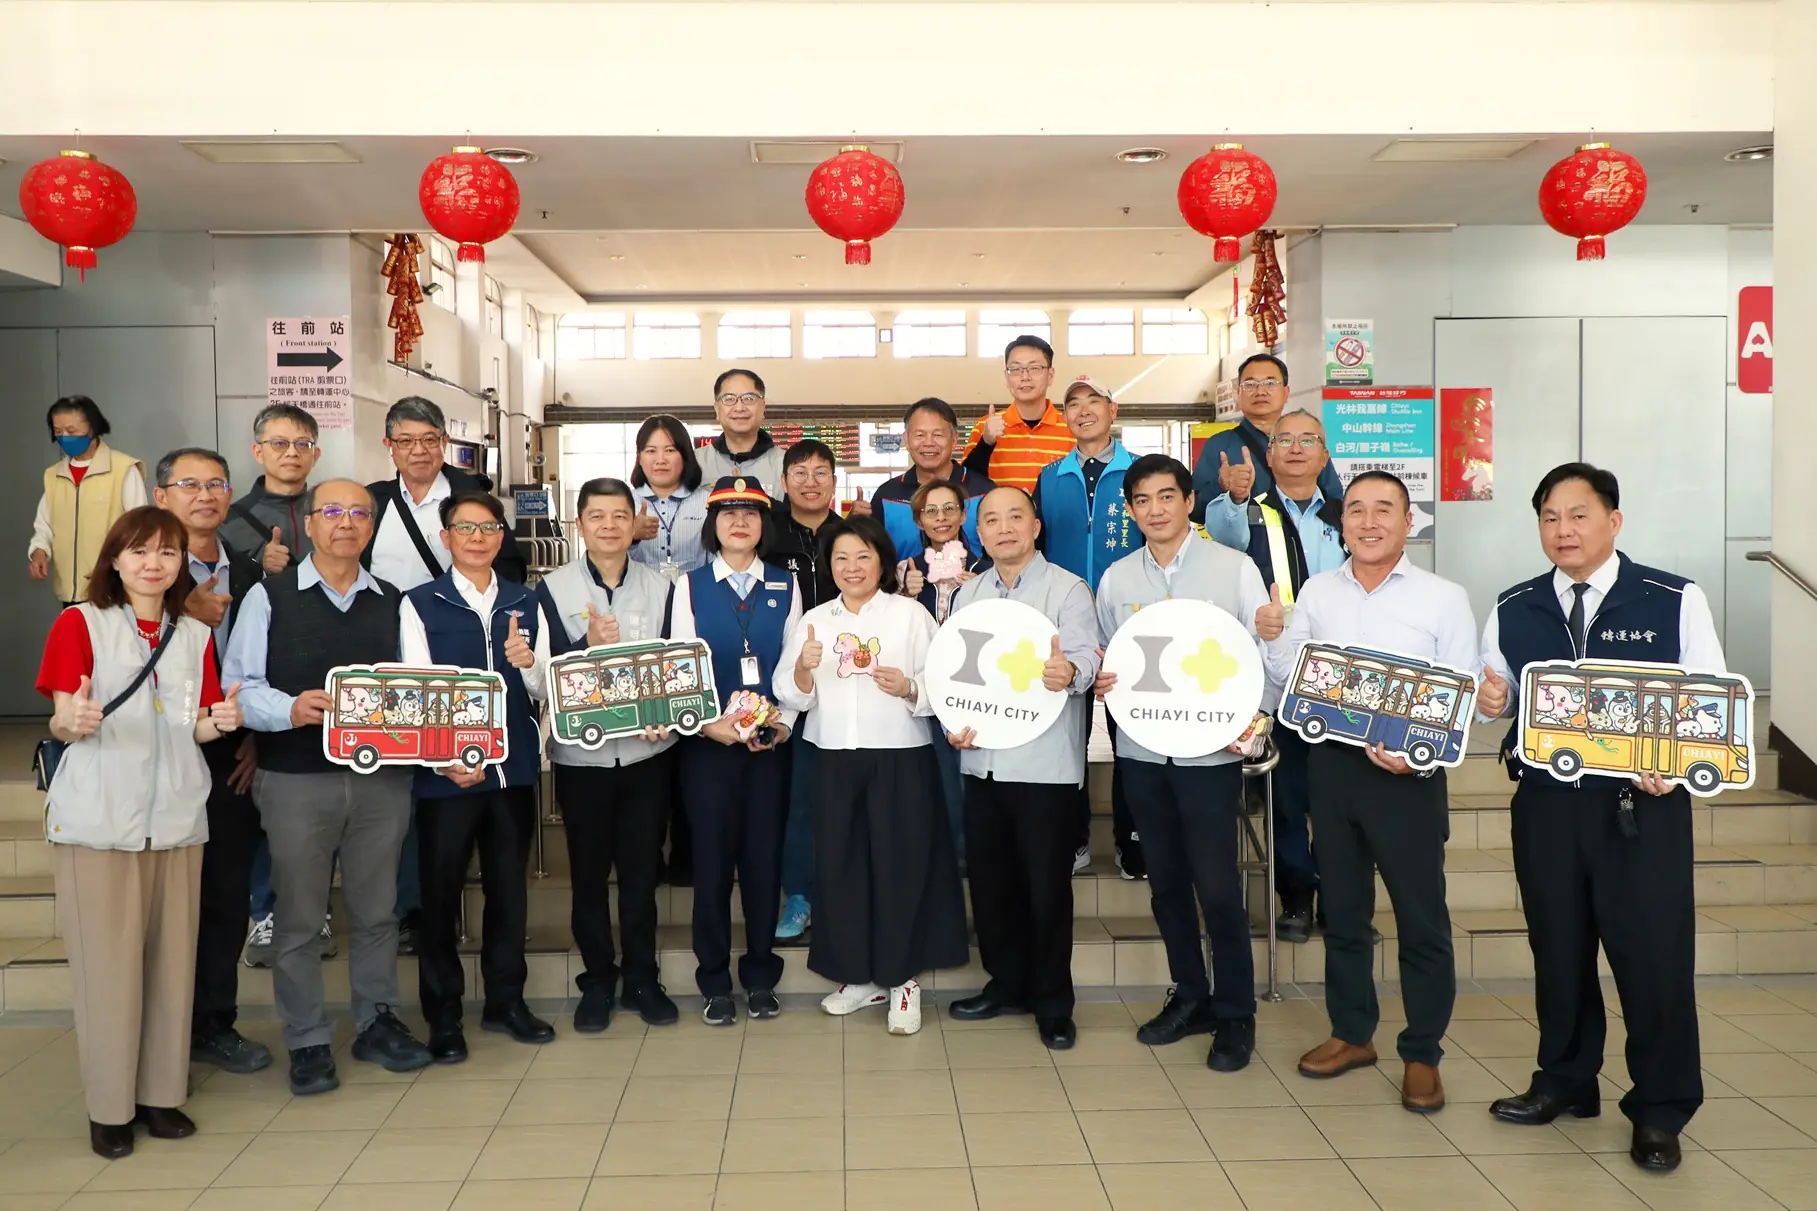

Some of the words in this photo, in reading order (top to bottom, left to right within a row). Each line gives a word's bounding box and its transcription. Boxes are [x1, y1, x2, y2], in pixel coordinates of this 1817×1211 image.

[272, 321, 344, 335] 往前站
[1741, 321, 1773, 359] A
[1342, 423, 1383, 433] 中山幹線
[1105, 502, 1119, 552] 蔡宗坤
[671, 697, 701, 708] CHIAYI
[945, 696, 998, 715] CHIAYI
[1004, 707, 1040, 722] CITY
[1130, 707, 1190, 722] CHIAYI
[1196, 711, 1236, 724] CITY
[457, 733, 488, 742] CHIAYI
[1410, 727, 1445, 742] CHIAYI
[1683, 748, 1725, 760] CHIAYI
